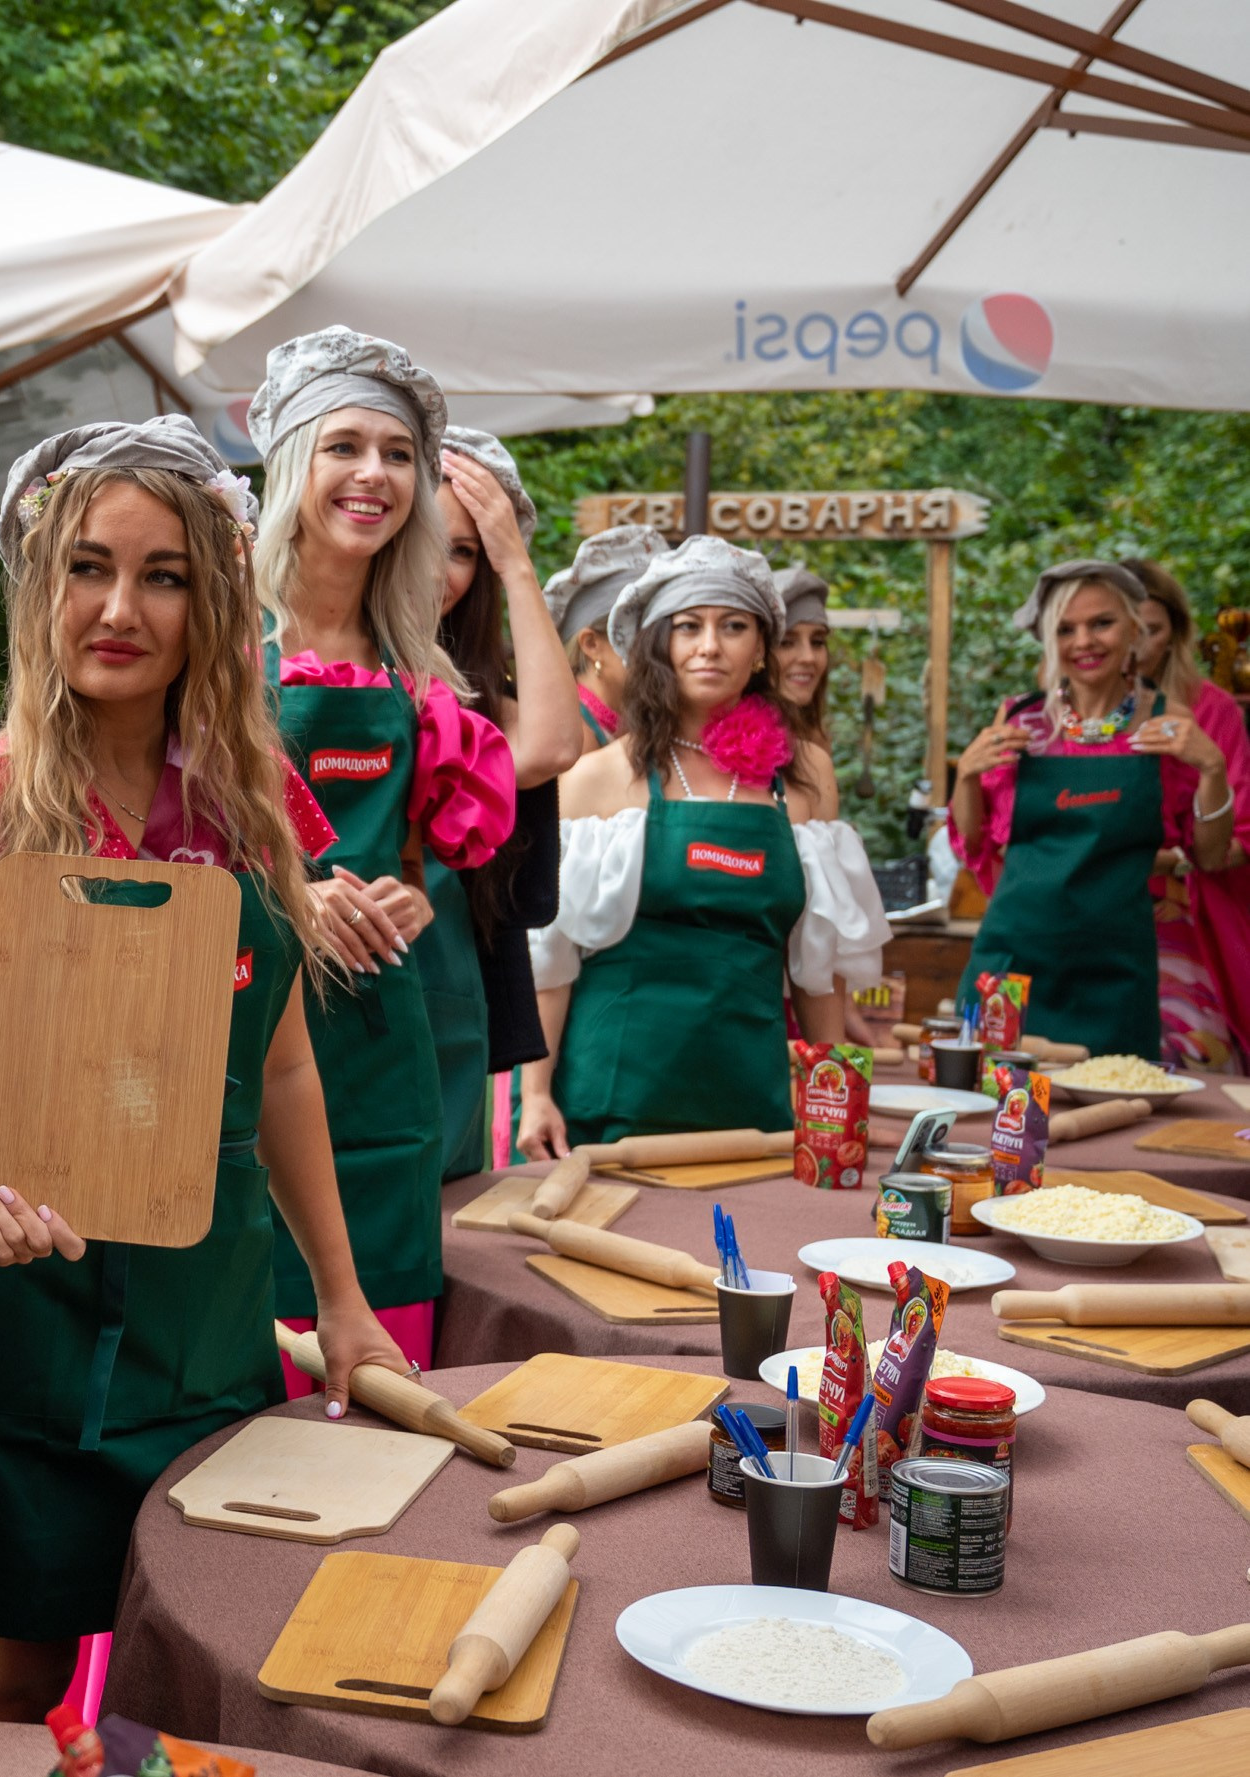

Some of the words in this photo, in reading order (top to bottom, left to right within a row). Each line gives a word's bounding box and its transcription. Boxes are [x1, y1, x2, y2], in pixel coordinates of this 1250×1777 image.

[609, 495, 951, 532] КВСОВАРНЯ
[314, 756, 388, 772] ПОМИДОРКА
[691, 848, 761, 872] ПОМИДОРКА
[806, 1103, 848, 1120] КЕТЧУП
[890, 1227, 927, 1238] СЛАДКАЯ
[877, 1356, 902, 1385] ЕТЧУП
[820, 1374, 846, 1405] ЕТЧУ
